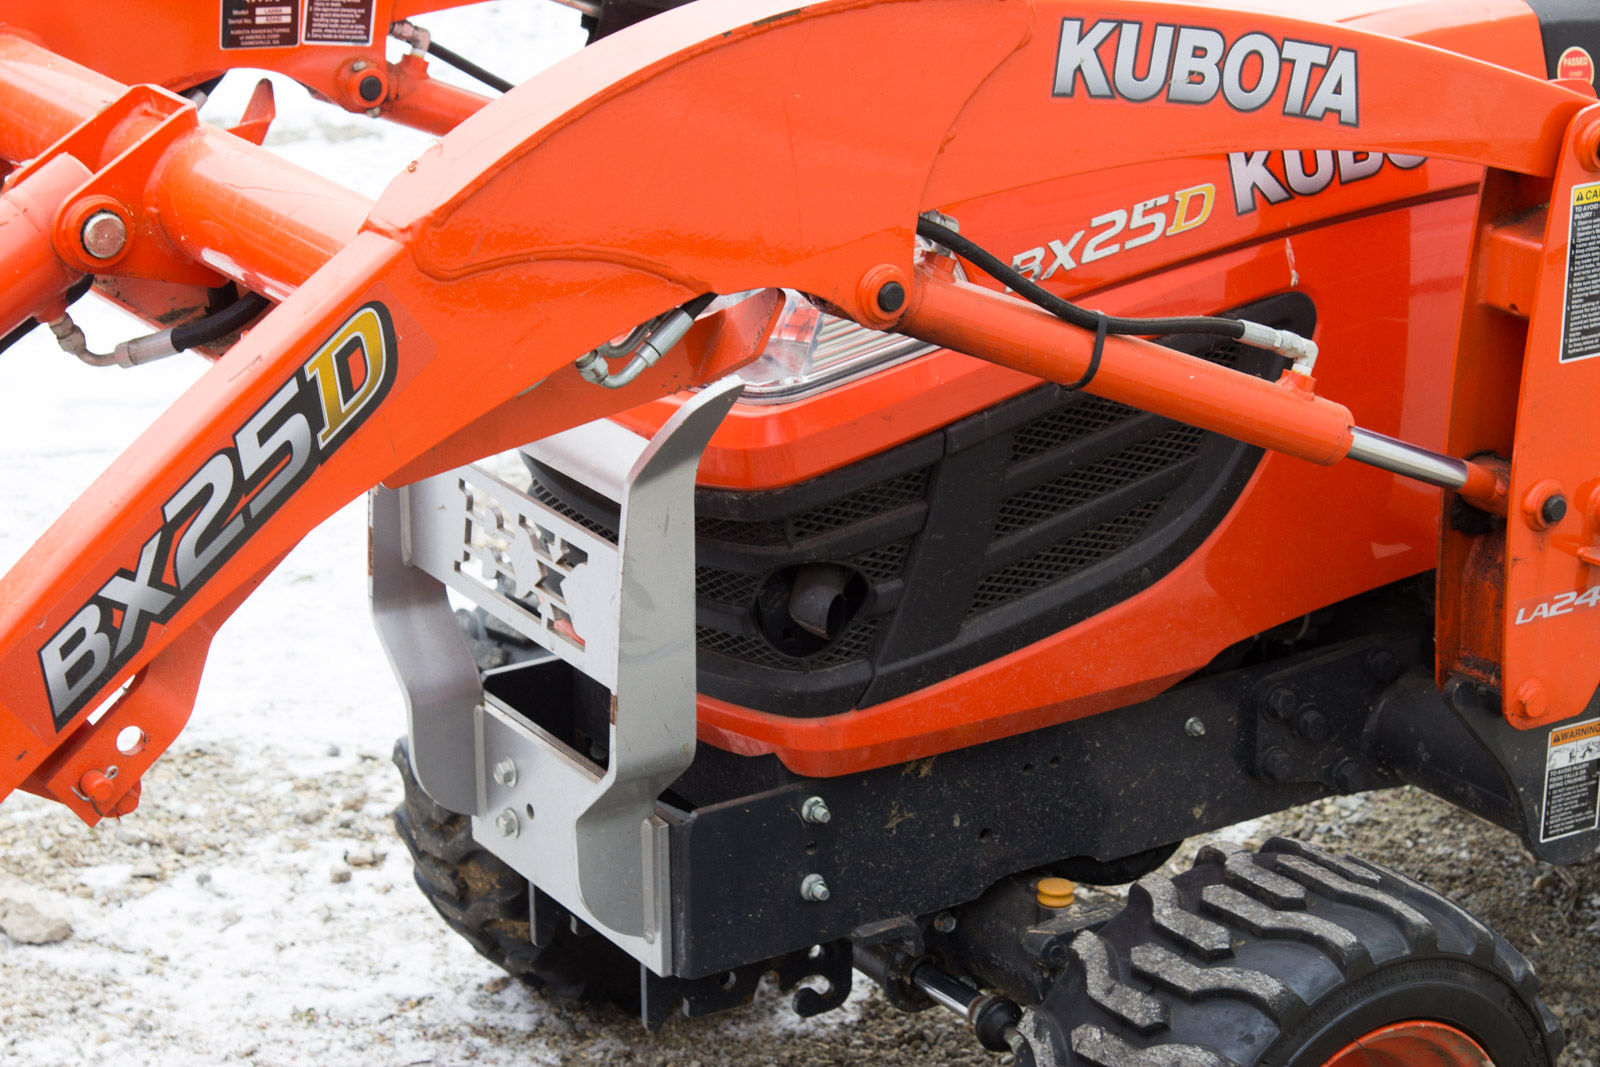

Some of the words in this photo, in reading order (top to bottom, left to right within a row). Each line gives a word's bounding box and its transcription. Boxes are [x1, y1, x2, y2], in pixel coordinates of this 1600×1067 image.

[1563, 56, 1588, 67] PASSED
[1052, 17, 1359, 127] KUBOTA
[1228, 148, 1428, 226] KU
[1586, 186, 1600, 201] CA
[1575, 205, 1583, 213] TO
[1583, 202, 1599, 211] AVOID
[1575, 211, 1593, 220] INJURY
[1005, 182, 1217, 290] BX25D
[38, 302, 395, 730] BX25D
[1561, 723, 1600, 742] WARNING
